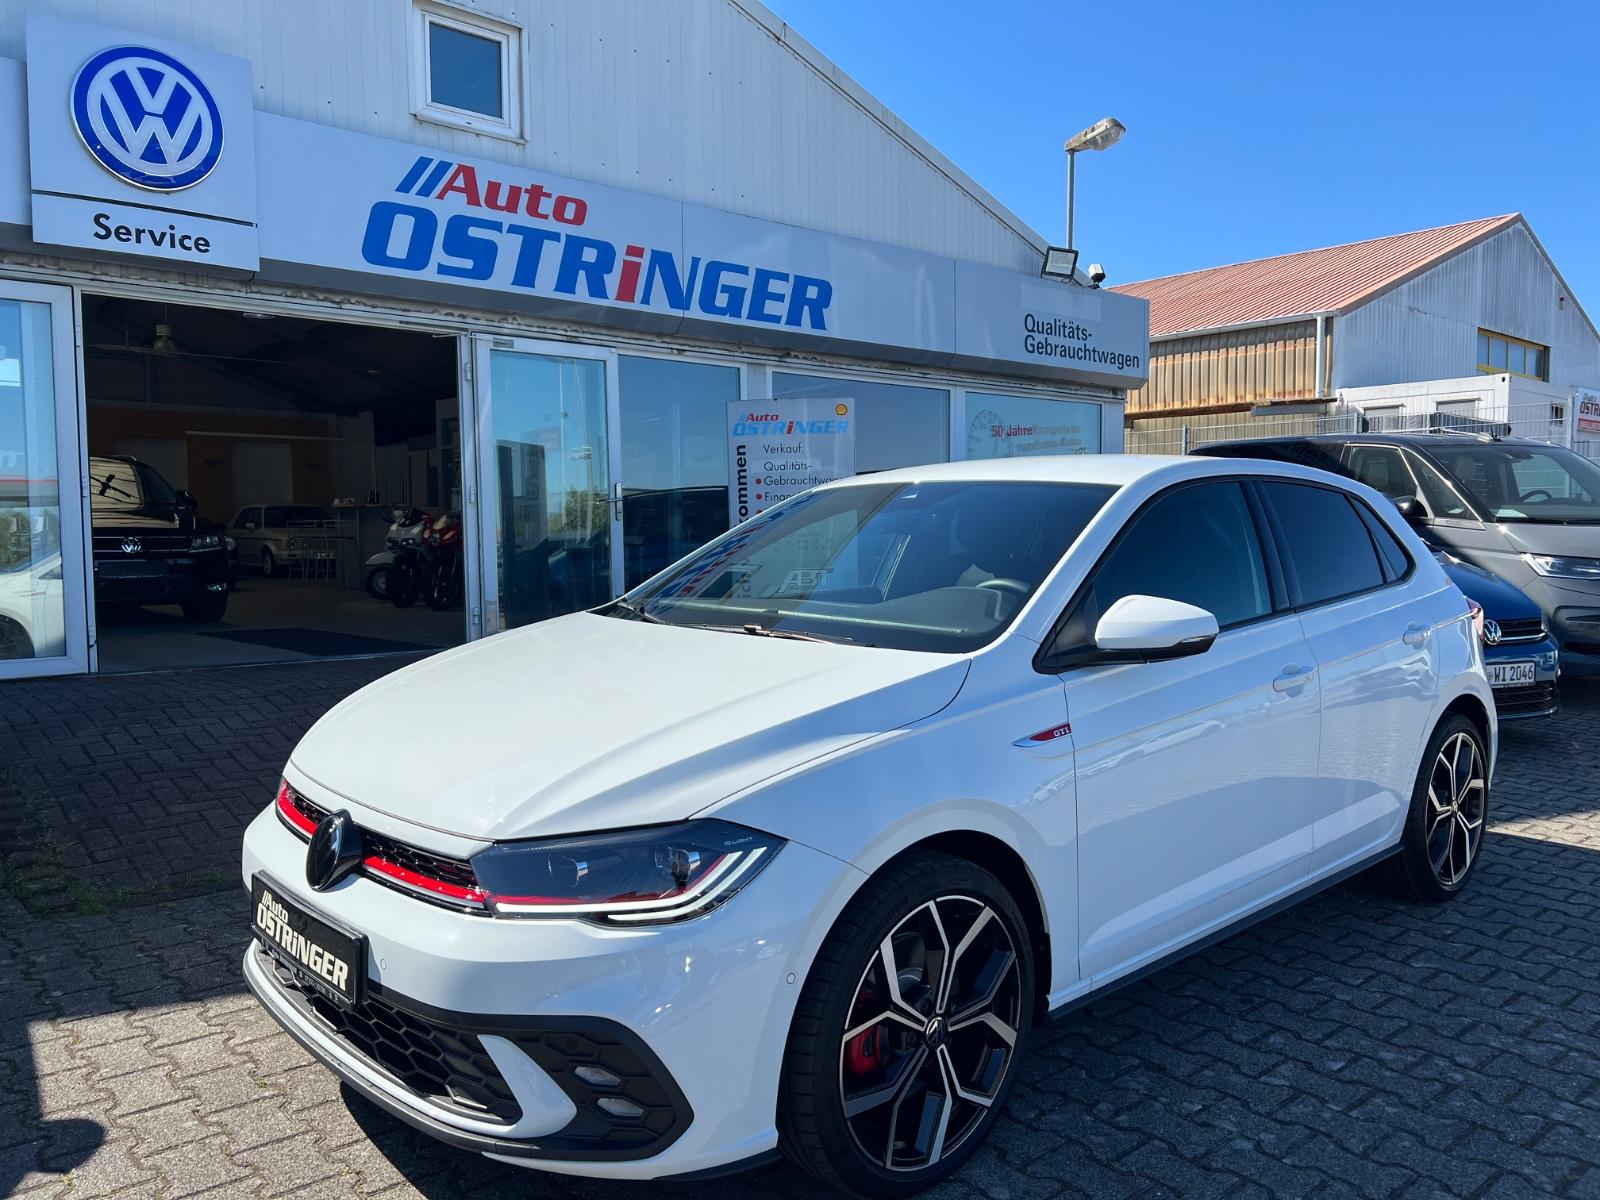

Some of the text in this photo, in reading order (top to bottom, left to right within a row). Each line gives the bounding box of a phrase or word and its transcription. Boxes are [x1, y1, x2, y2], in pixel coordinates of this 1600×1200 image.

[436, 163, 588, 226] Auto
[93, 212, 211, 254] Service
[1024, 314, 1092, 341] Qualitäts-
[1024, 335, 1140, 370] Gebrauchtwagen
[1580, 400, 1600, 416] OSTR
[746, 413, 779, 422] Auto
[991, 425, 1003, 437] 50
[1006, 424, 1033, 437] Jahre
[763, 442, 805, 454] Verkauf:
[763, 460, 813, 472] Qualitäts-
[1053, 727, 1070, 737] GTI
[264, 891, 289, 924] Auto
